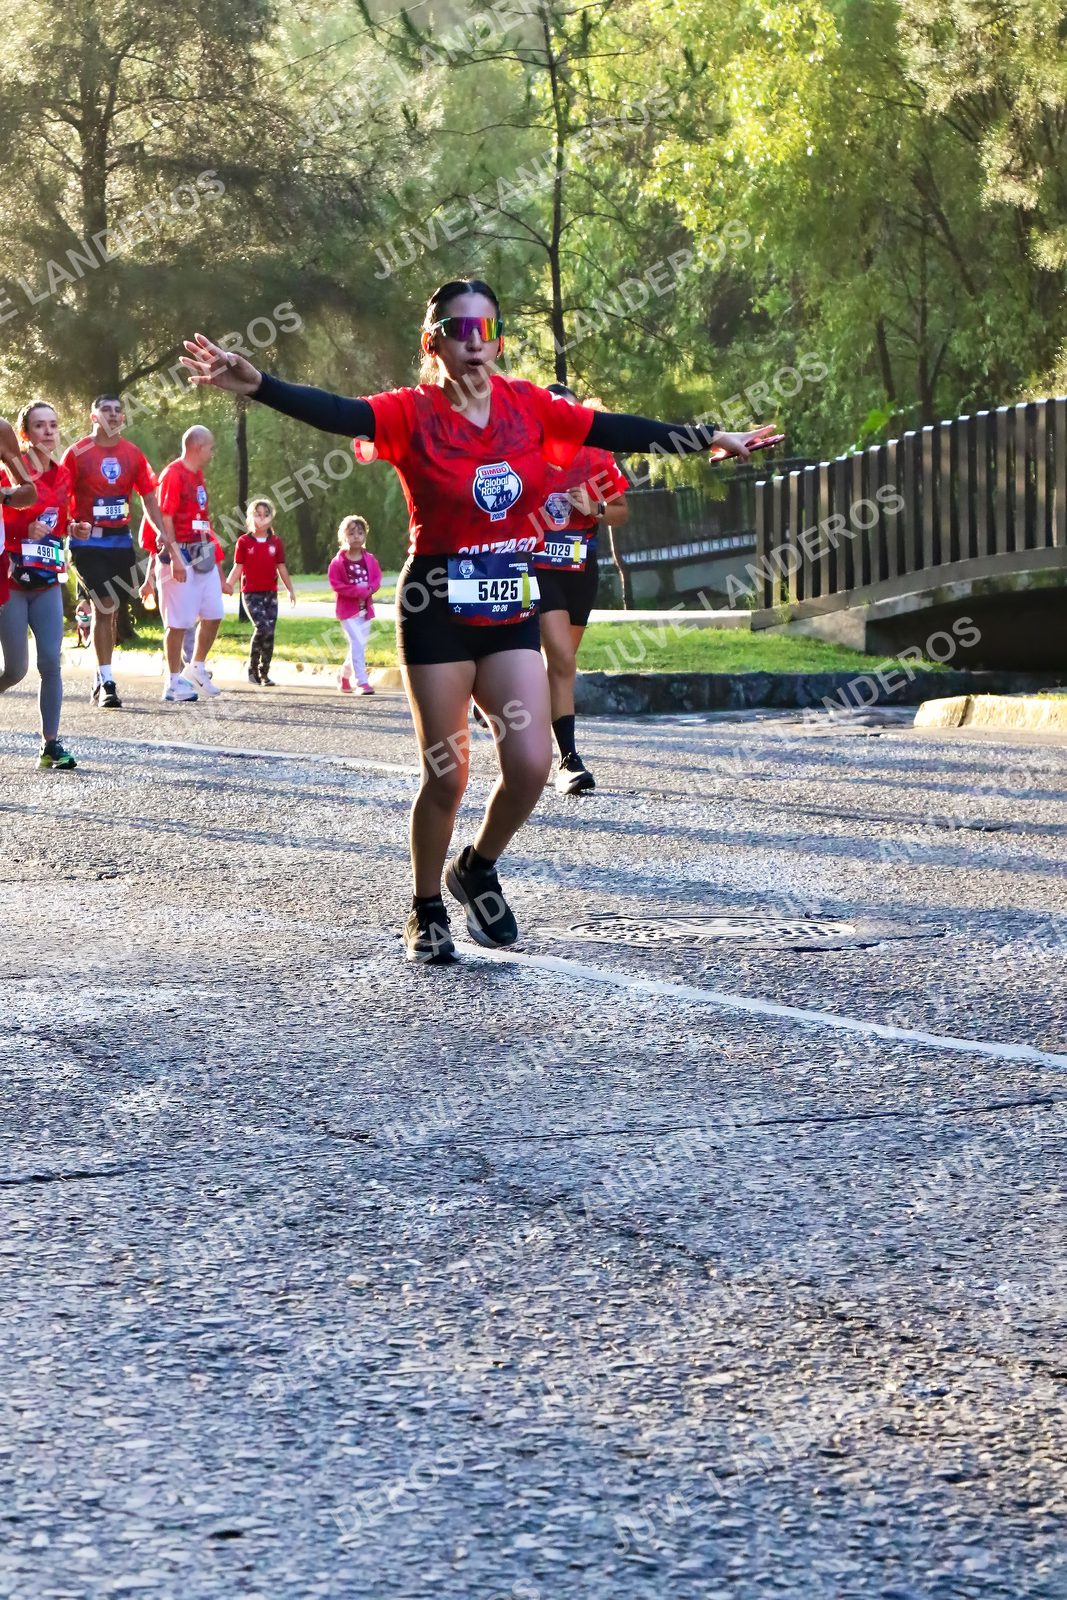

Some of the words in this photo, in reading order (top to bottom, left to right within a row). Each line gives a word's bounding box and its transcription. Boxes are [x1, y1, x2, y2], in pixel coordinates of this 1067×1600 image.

[484, 476, 508, 488] Global
[481, 486, 501, 496] Race
[37, 546, 54, 557] 4981
[545, 544, 571, 556] 4029
[478, 580, 518, 601] 5425
